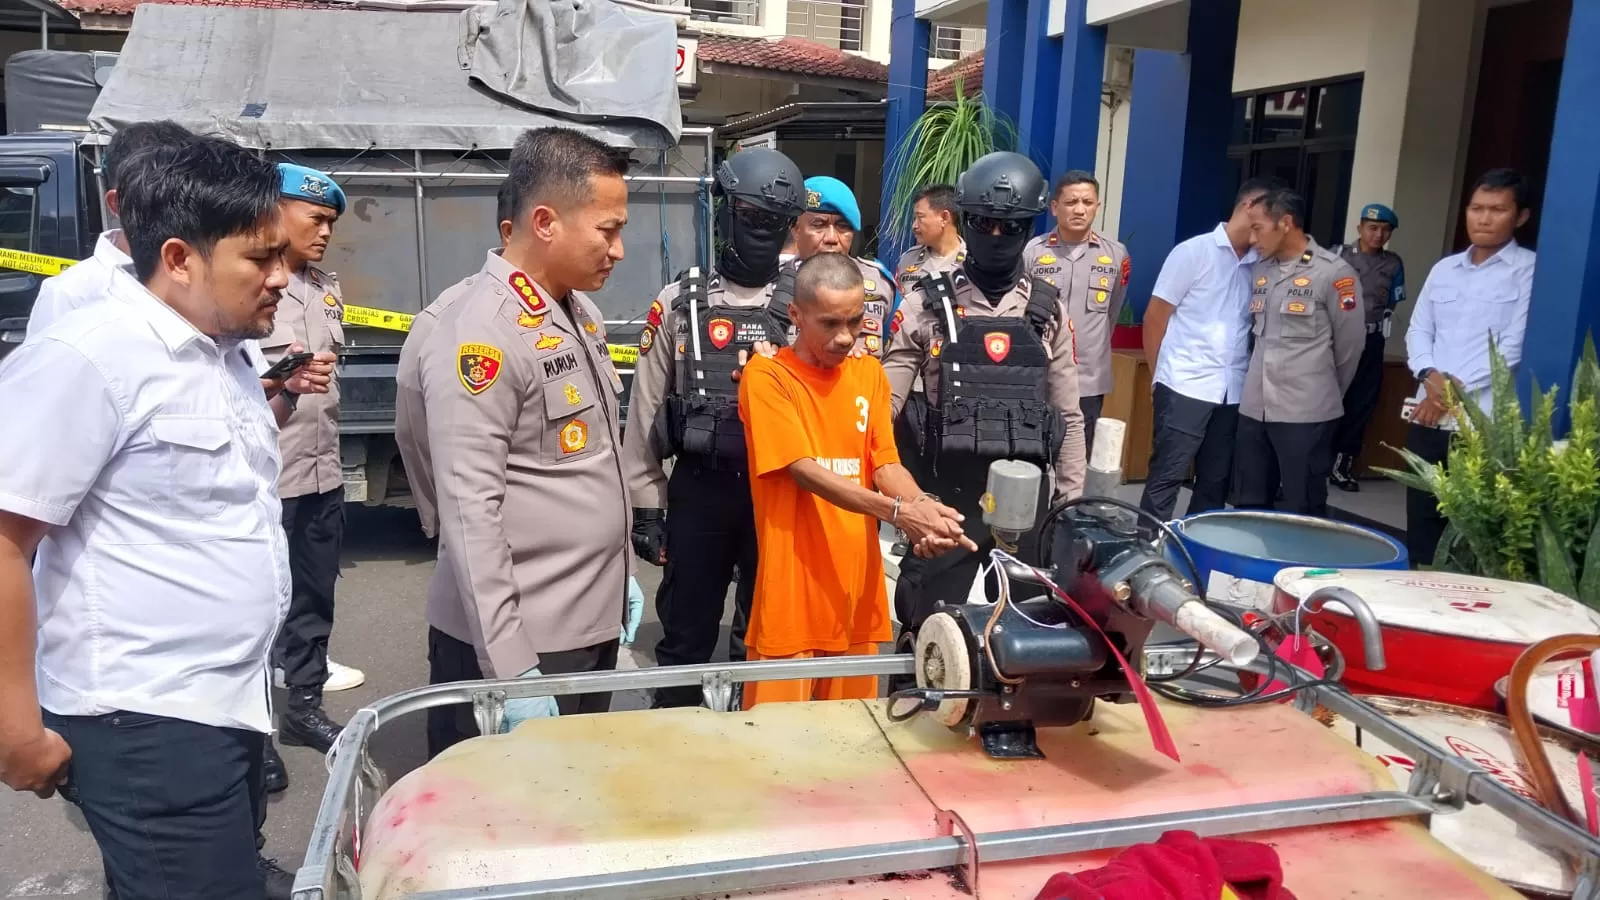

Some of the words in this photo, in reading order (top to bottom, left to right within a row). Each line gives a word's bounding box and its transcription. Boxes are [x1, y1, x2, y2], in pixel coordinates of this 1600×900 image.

[20, 253, 55, 265] MELINTAS
[2, 259, 16, 268] NOT
[19, 262, 44, 273] CROSS
[1091, 265, 1116, 275] POLRI
[1287, 288, 1313, 297] POLRI
[346, 307, 379, 317] MELINTAS
[863, 303, 882, 316] LRI
[346, 314, 369, 324] CROSS
[543, 352, 579, 378] RURUH
[856, 395, 869, 432] 3
